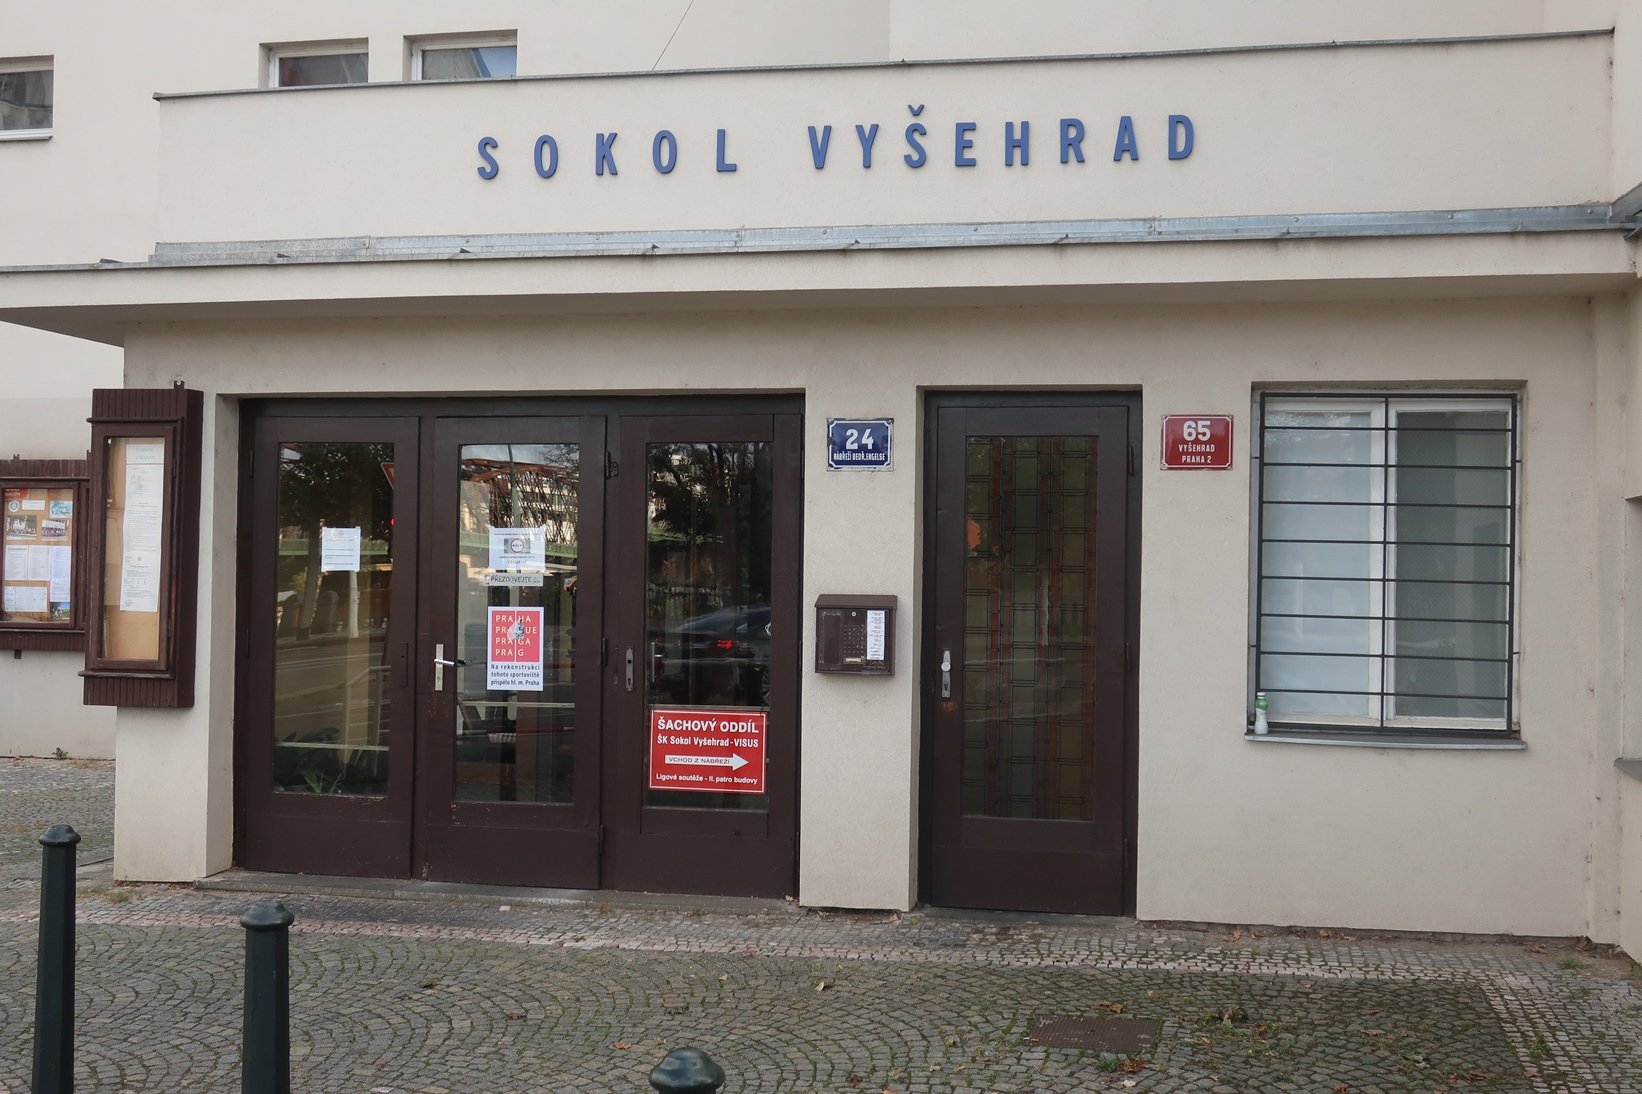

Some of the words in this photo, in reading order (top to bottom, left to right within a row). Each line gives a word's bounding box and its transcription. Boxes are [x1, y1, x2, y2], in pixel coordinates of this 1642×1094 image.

[477, 128, 738, 181] SOKOL
[807, 103, 1195, 170] VYŠEHRAD
[1183, 420, 1211, 441] 65
[845, 428, 874, 450] 24
[1178, 442, 1215, 452] VYŠEHRAD
[495, 626, 537, 634] PRAUE
[657, 716, 716, 731] ŠACHOVÝ
[720, 719, 759, 733] ODDÍL
[657, 734, 668, 744] ŠK
[670, 735, 691, 745] Sokol
[656, 773, 677, 782] Ligové
[715, 775, 733, 784] patro
[733, 776, 758, 785] budovy
